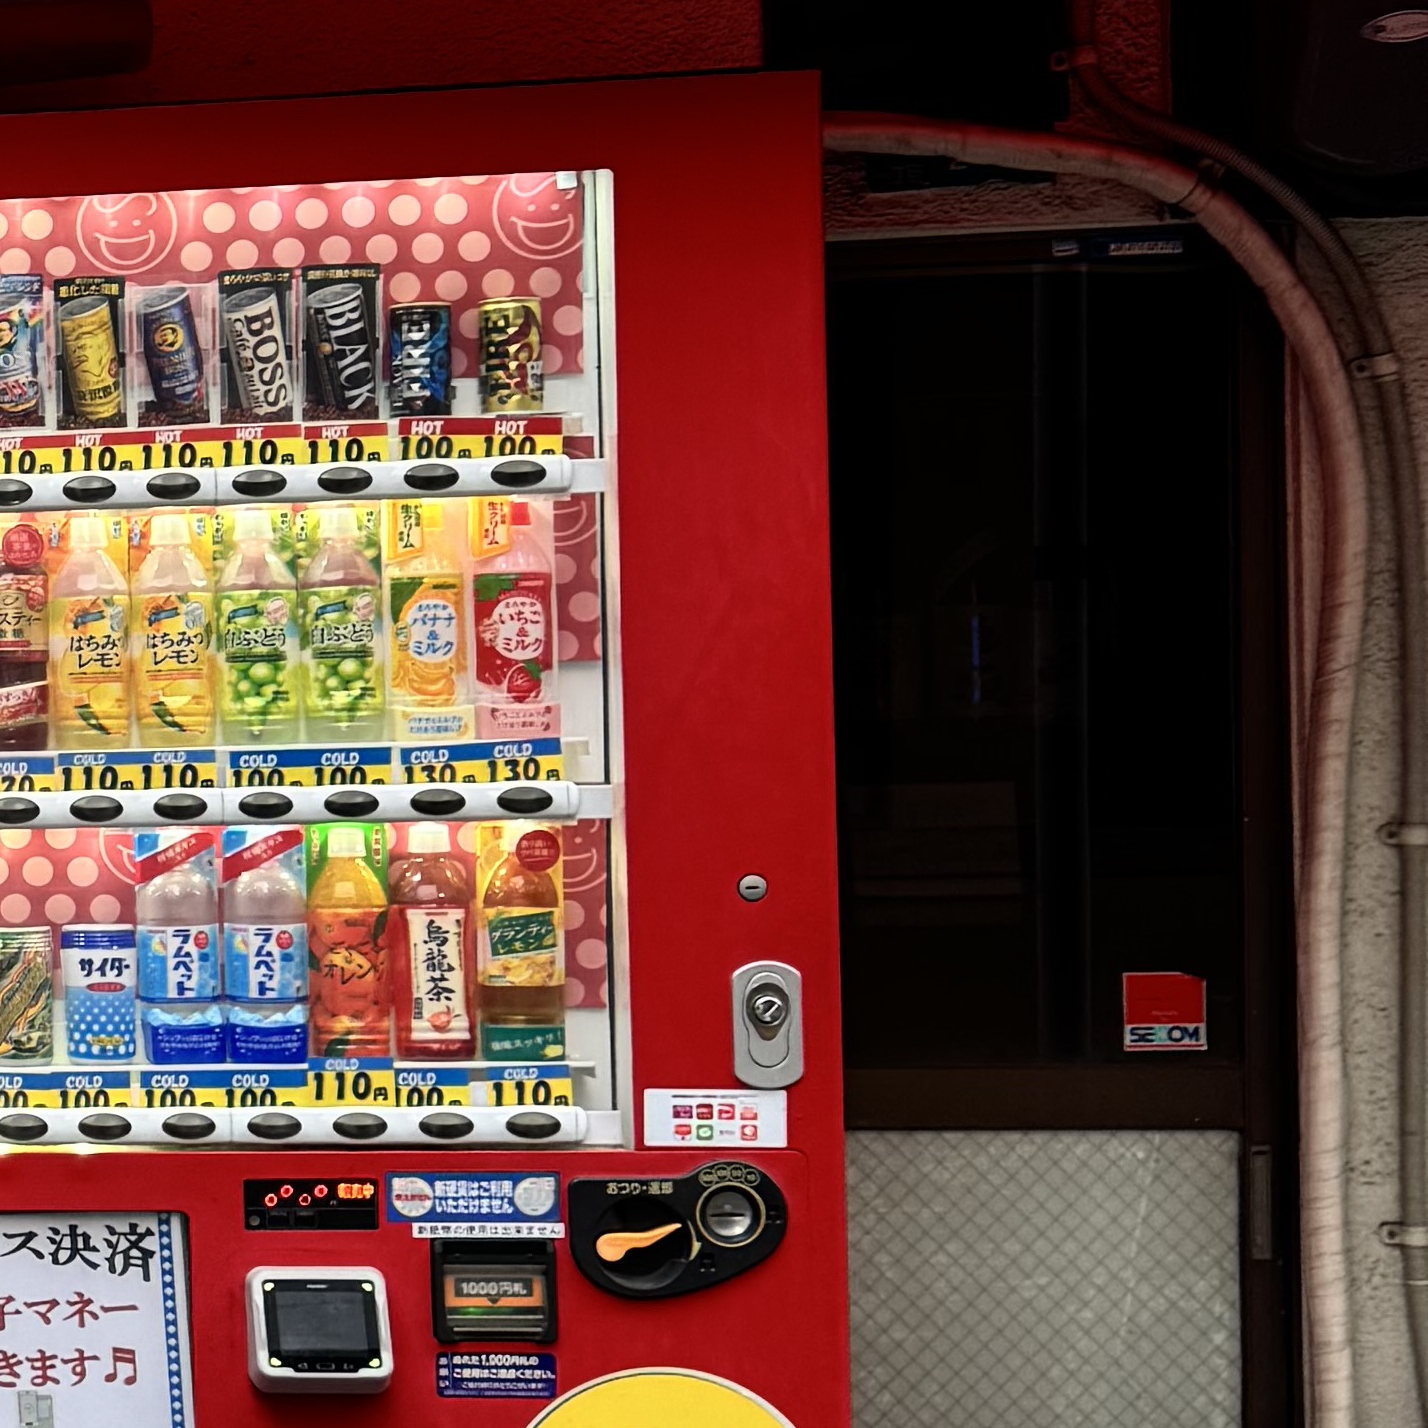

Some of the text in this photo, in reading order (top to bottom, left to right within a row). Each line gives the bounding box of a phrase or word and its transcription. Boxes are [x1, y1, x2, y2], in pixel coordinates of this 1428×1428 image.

[244, 305, 287, 409] BOSS
[323, 300, 375, 410] BLACK
[236, 426, 264, 441] HOT
[321, 425, 349, 439] HOT
[411, 420, 445, 435] HOT
[494, 420, 529, 435] HOT
[75, 434, 103, 448] HOT
[155, 430, 183, 444] HOT
[411, 613, 456, 629] バナナ
[499, 610, 541, 626] いちご
[147, 632, 204, 652] はちみつ
[411, 640, 456, 657] ミルク
[502, 637, 544, 653] ミルク
[77, 653, 122, 669] レモン
[153, 651, 200, 666] レモン
[153, 751, 187, 763] COLD
[410, 749, 449, 763] COLD
[494, 743, 532, 757] COLD
[73, 753, 107, 765] COLD
[239, 754, 278, 768] COLD
[321, 752, 359, 766] COLD
[78, 957, 131, 978] サイダー
[422, 919, 456, 1002] 烏龍茶
[1130, 1026, 1199, 1042] SECOM
[325, 1059, 358, 1070] COLD
[398, 1072, 436, 1085] COLD
[505, 1068, 538, 1079] COLD
[65, 1076, 103, 1089] COLD
[151, 1075, 189, 1088] COLD
[232, 1075, 270, 1087] COLD
[314, 1072, 388, 1101] 110円
[461, 1281, 528, 1295] 1000円札
